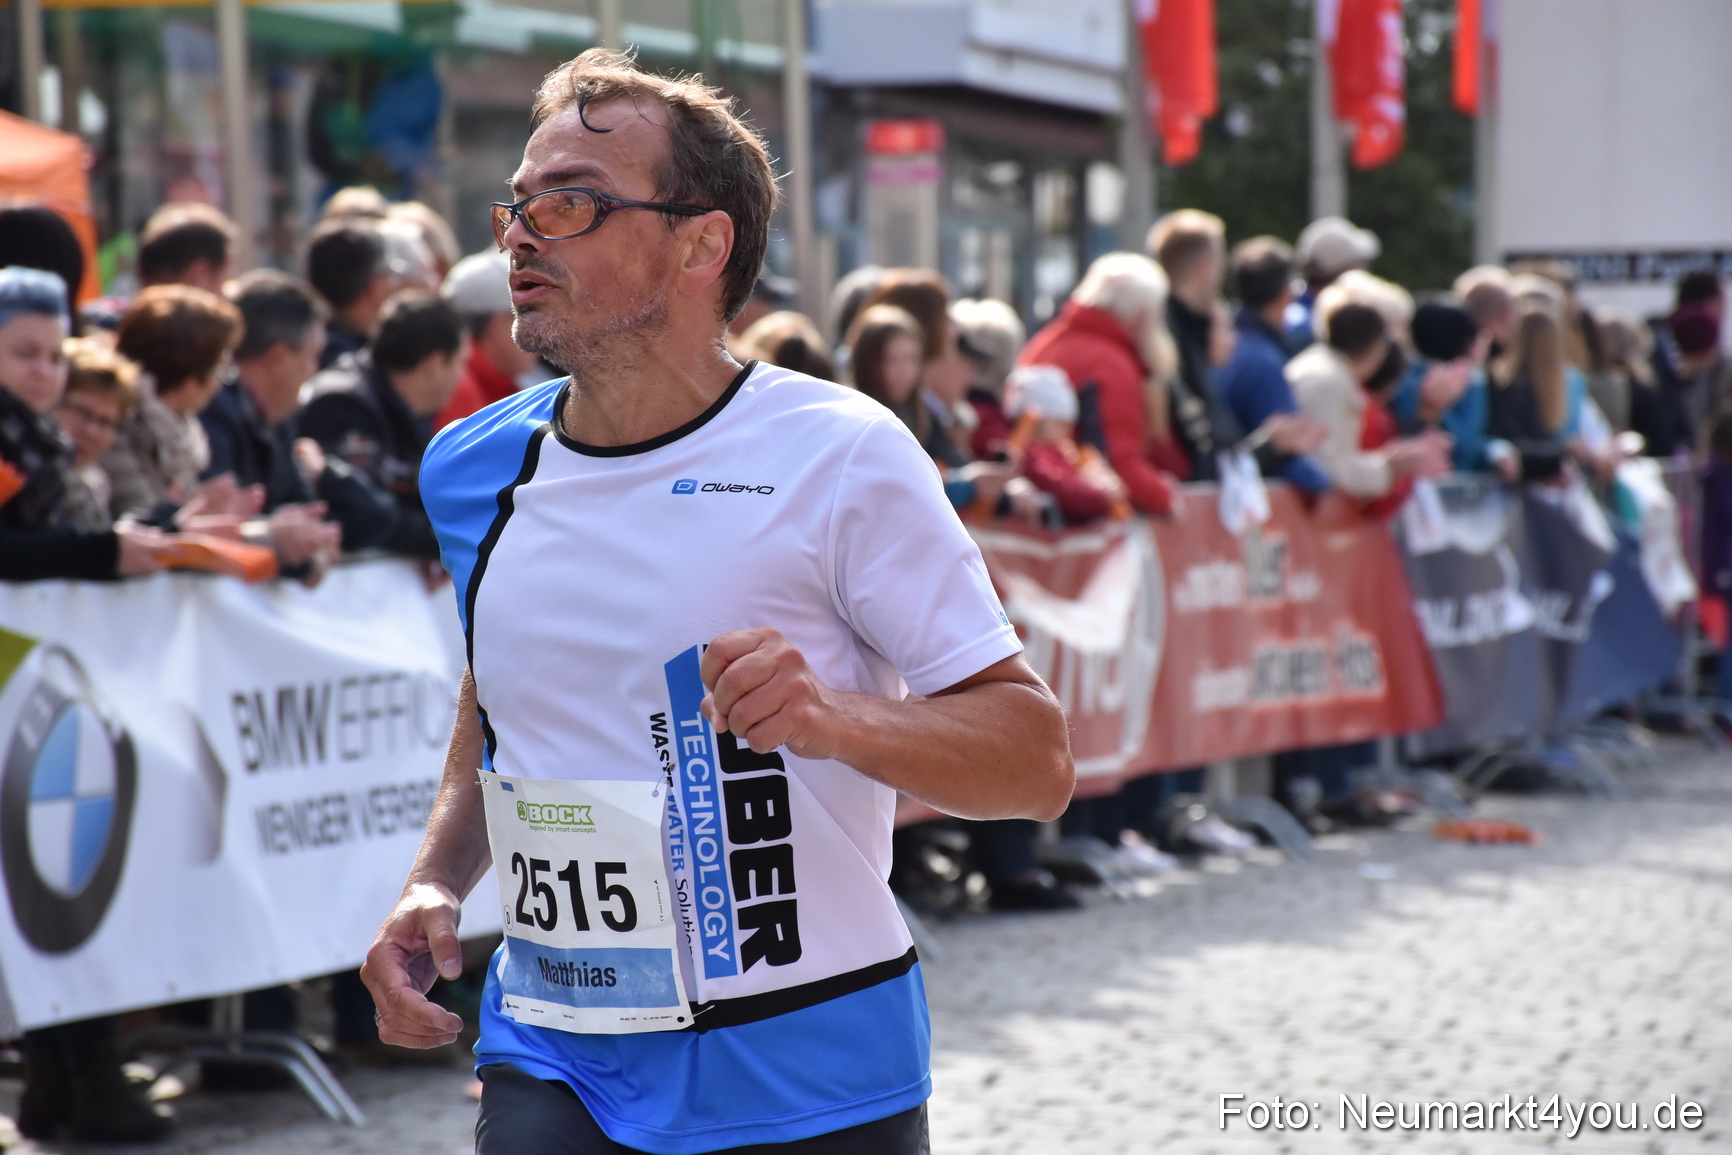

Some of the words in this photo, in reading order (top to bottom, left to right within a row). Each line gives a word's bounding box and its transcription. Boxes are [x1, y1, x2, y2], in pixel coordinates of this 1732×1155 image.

[230, 684, 332, 774] BMW
[527, 803, 595, 825] BOCK
[547, 825, 555, 833] by
[571, 826, 597, 835] concepts
[667, 794, 686, 873] WATER
[679, 711, 731, 963] TECHNOLOGY
[702, 643, 803, 975] UBER
[511, 852, 637, 933] 2515
[538, 956, 617, 989] Matthias
